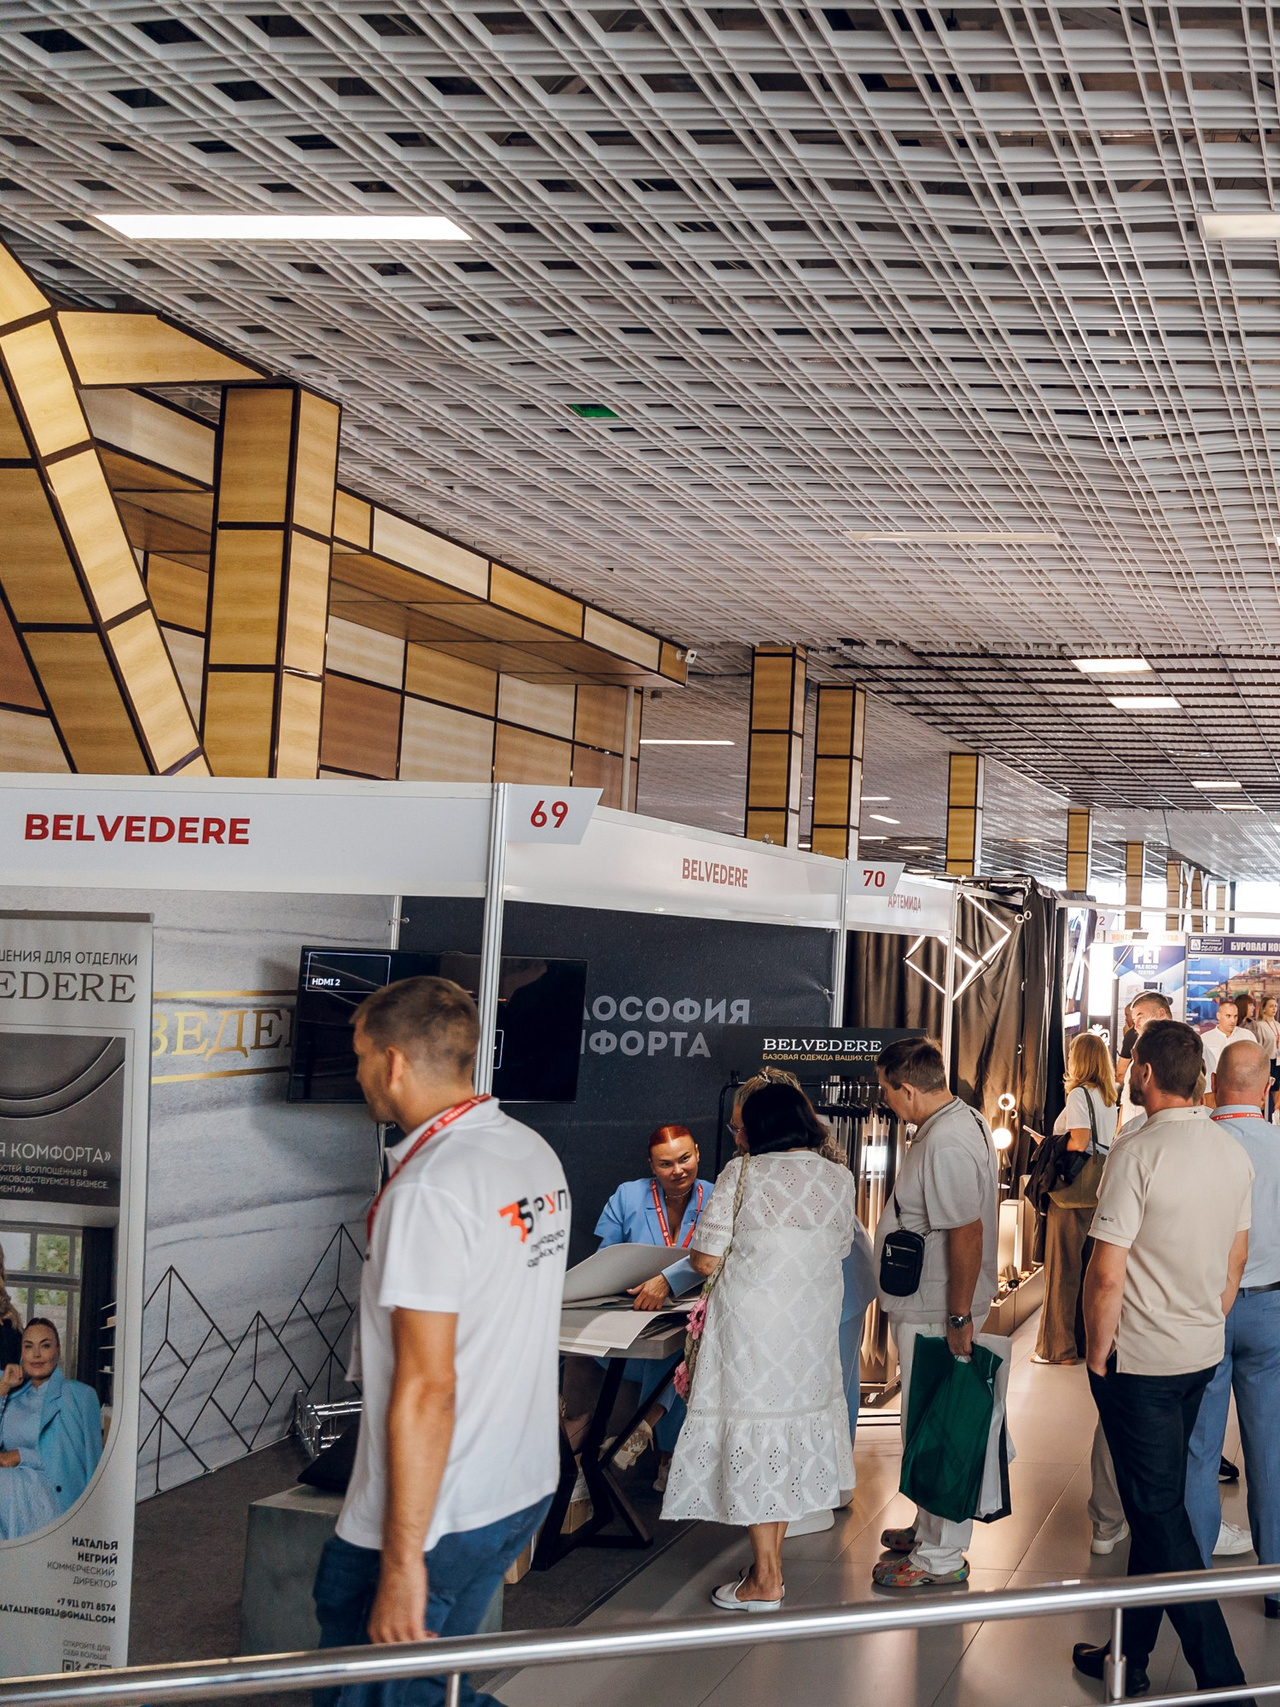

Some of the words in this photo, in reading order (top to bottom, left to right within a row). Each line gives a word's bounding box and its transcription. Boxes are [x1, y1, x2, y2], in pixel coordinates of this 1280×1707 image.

[530, 800, 569, 829] 69
[24, 813, 251, 845] BELVEDERE
[681, 857, 749, 889] BELVEDERE
[863, 870, 886, 888] 70
[887, 894, 922, 913] АРТЕМИДА
[1230, 941, 1266, 952] БУРОВАЯ
[44, 950, 72, 964] ДЛЯ
[75, 951, 138, 966] ОТДЕЛКИ
[1132, 946, 1162, 964] PET
[311, 977, 334, 987] HDMI
[335, 977, 341, 987] 2
[580, 1029, 712, 1058] ФОРТА
[763, 1038, 883, 1053] BELVEDERE
[762, 1052, 799, 1062] БАЗОВАЯ
[799, 1053, 834, 1063] ОДЕЖДА
[835, 1054, 864, 1063] ВАШИХ
[11, 1143, 111, 1164] КОМФОРТА»
[71, 1536, 118, 1550] НАТАЛЬЯ
[78, 1551, 118, 1565] НЕГРИЙ
[46, 1561, 115, 1577] КОММЕРЧЕСКИЙ
[72, 1576, 118, 1589] ДИРЕКТОР
[57, 1597, 65, 1606] +7
[67, 1598, 79, 1608] 911
[80, 1600, 94, 1610] 071
[95, 1602, 116, 1612] 8574
